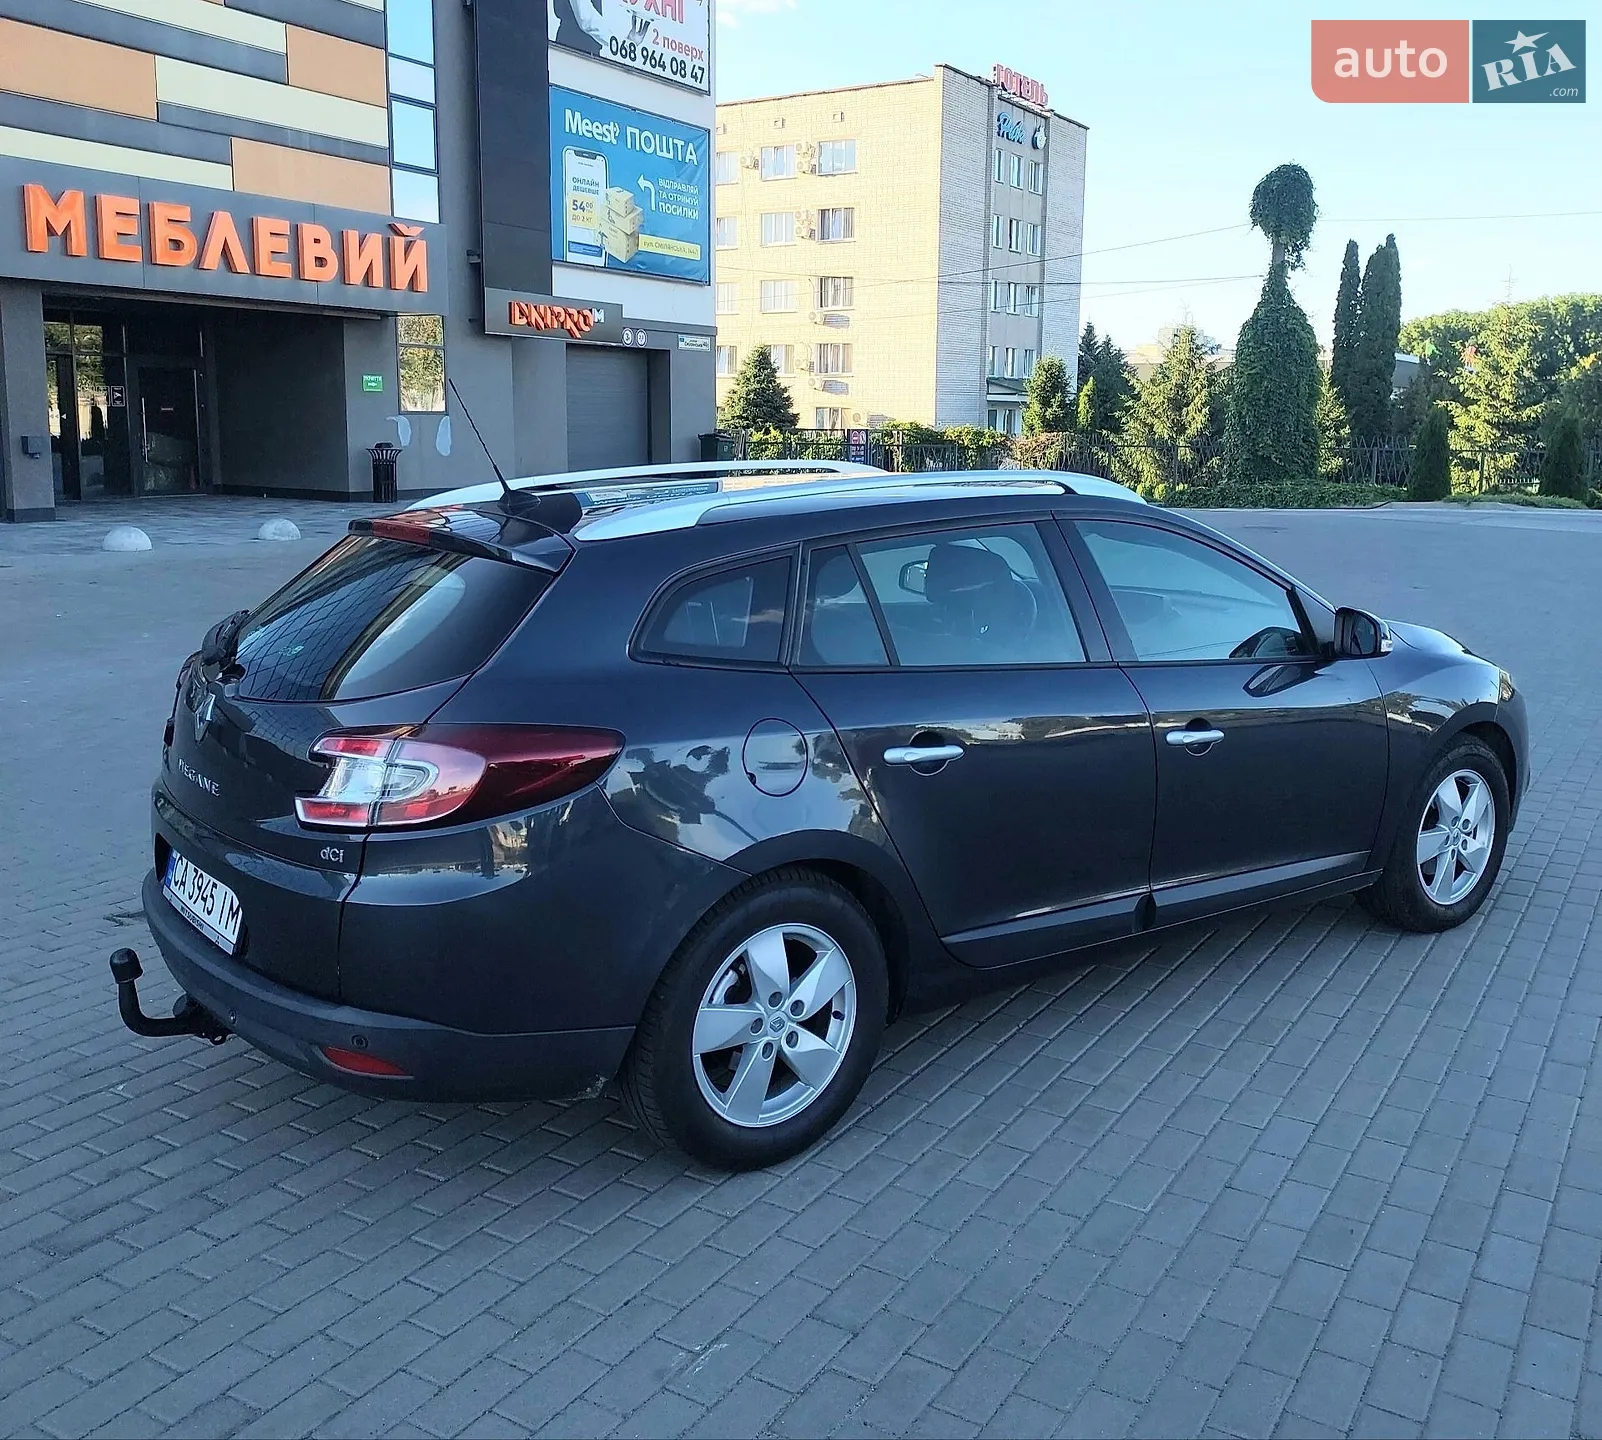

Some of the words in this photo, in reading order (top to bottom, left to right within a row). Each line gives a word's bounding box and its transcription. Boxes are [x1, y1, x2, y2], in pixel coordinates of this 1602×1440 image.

[609, 35, 638, 62] 068
[641, 46, 667, 72] 964
[669, 56, 687, 79] 08
[690, 63, 705, 84] 47
[652, 28, 660, 45] 2
[662, 38, 704, 63] поверх
[564, 108, 619, 145] Meest
[626, 126, 698, 166] ПОШТА
[572, 176, 600, 188] ОНЛАЙН
[572, 184, 599, 195] ДЕШЕВШЕ
[658, 178, 699, 194] ВІДПРАВЛЯЙ
[658, 190, 668, 199] ТА
[658, 201, 699, 220] ПОСИЛКИ
[22, 182, 428, 293] МЕБЛЕВИЙ
[509, 301, 594, 339] DNIPRO
[178, 758, 220, 797] MEGANE
[320, 846, 345, 863] dCi
[173, 855, 189, 895] CA
[188, 866, 218, 916] 3945
[218, 891, 241, 936] IM
